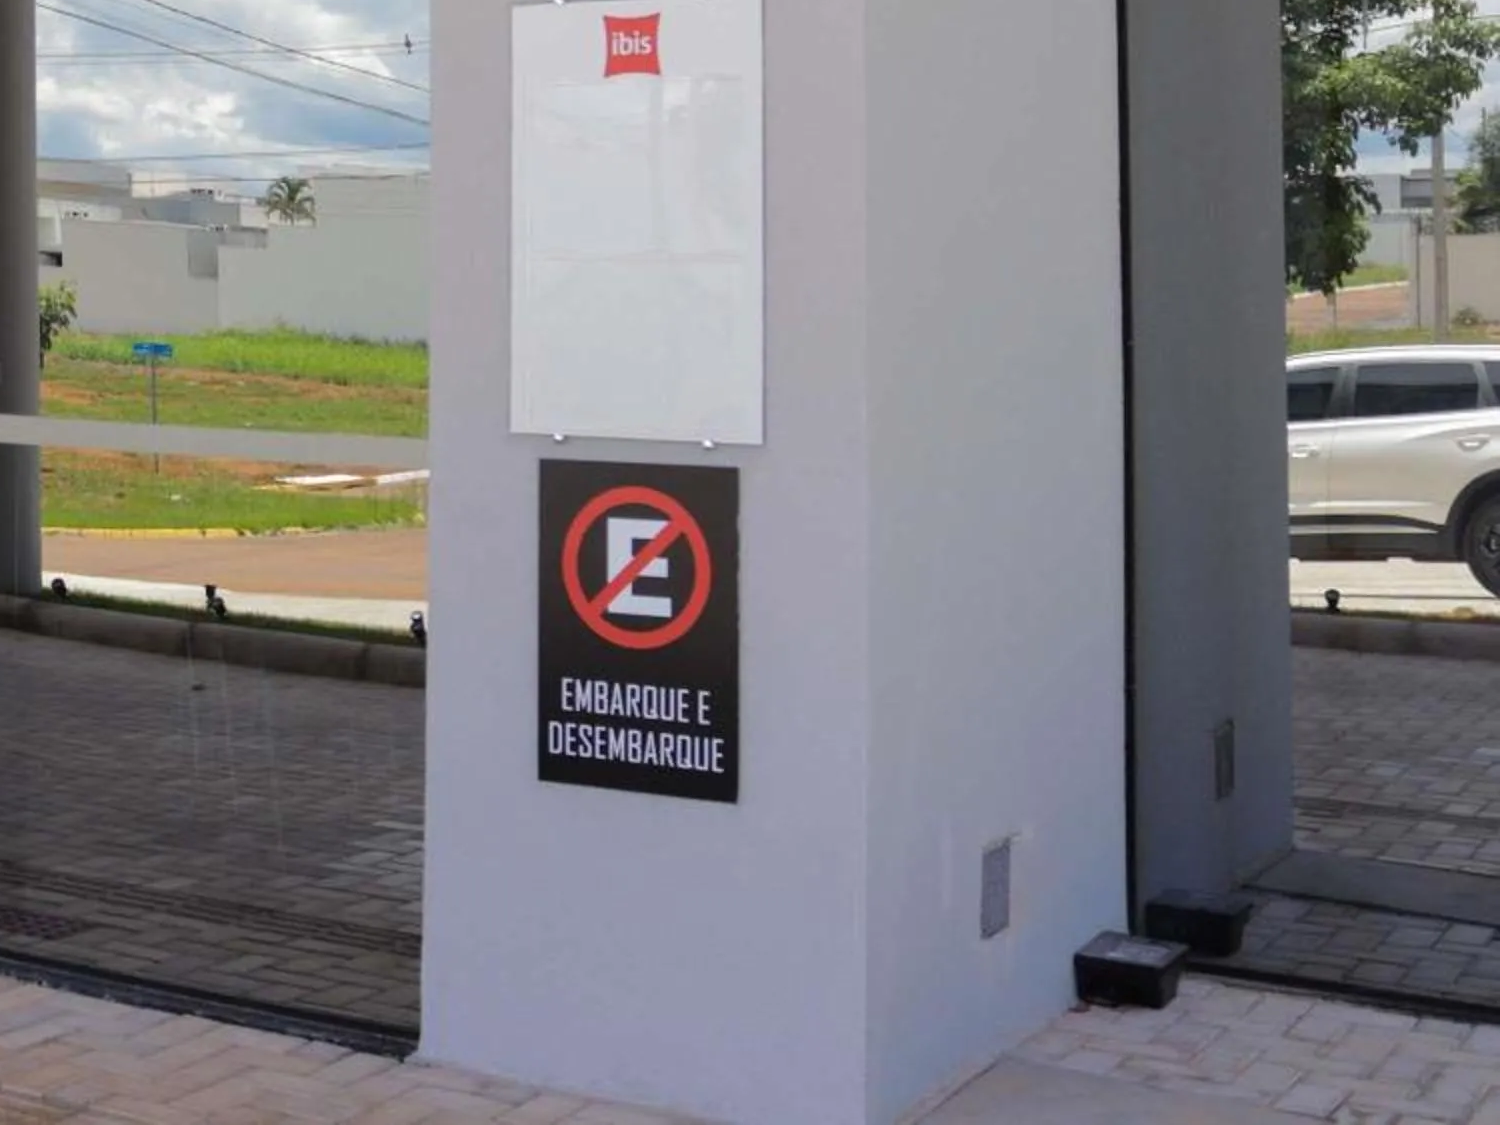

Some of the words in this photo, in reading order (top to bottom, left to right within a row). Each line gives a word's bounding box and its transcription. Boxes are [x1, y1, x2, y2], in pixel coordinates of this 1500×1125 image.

[611, 29, 652, 56] ibis
[561, 676, 690, 724] EMBARQUE
[697, 690, 711, 725] E
[547, 720, 725, 773] DESEMBARQUE
